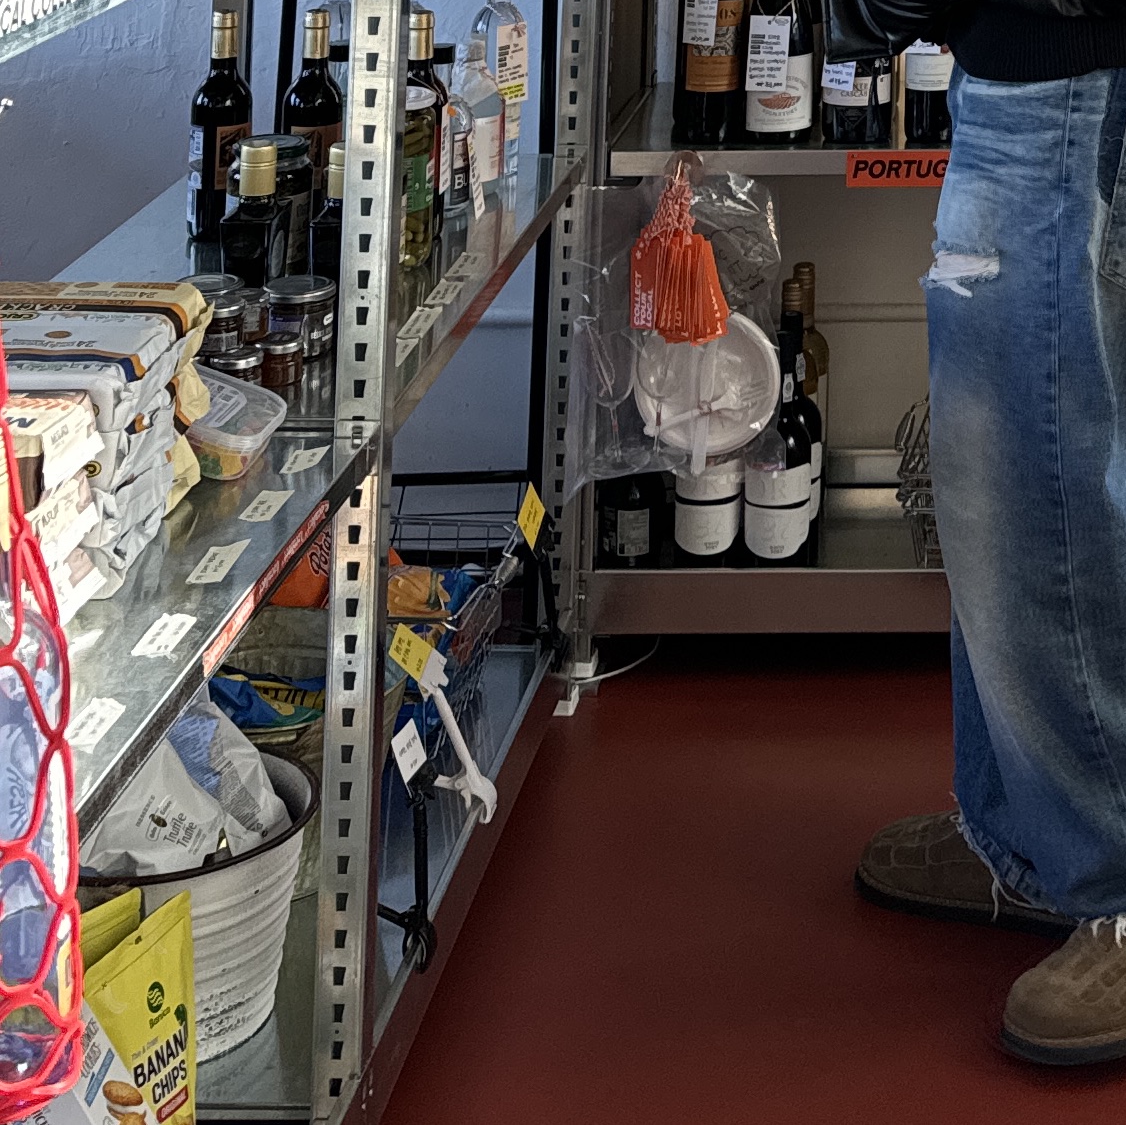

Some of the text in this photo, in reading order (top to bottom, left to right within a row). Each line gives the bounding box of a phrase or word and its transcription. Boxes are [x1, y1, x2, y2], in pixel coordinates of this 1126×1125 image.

[852, 158, 949, 179] PORTUG
[633, 270, 642, 326] COLLECT
[152, 1059, 187, 1105] CHIPS
